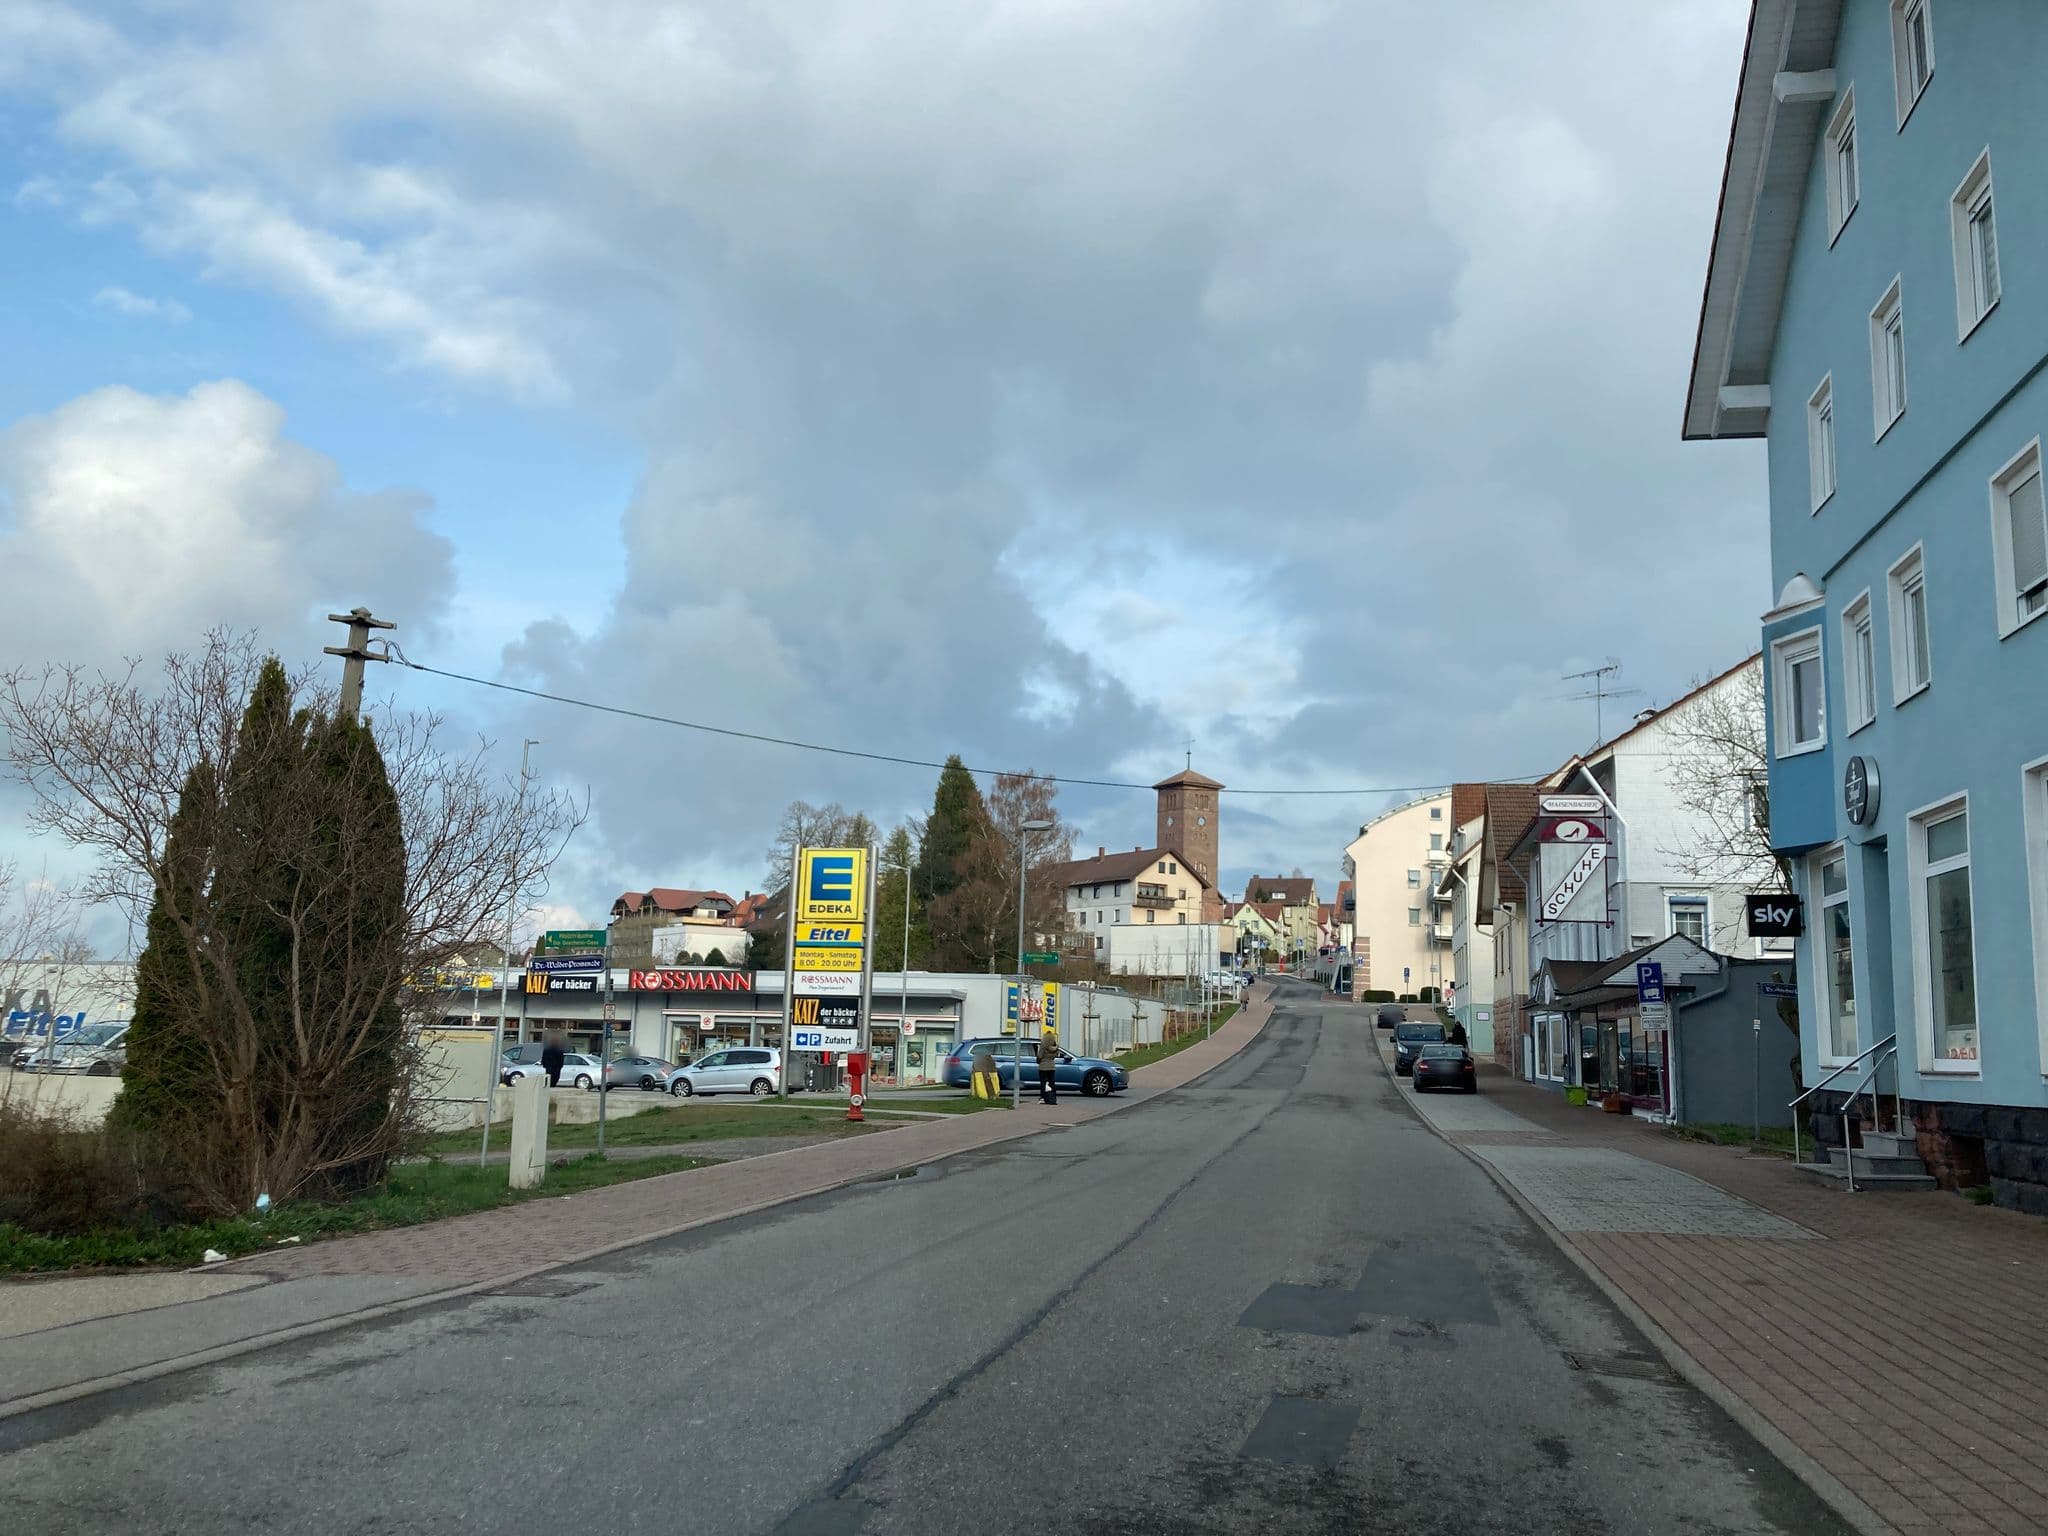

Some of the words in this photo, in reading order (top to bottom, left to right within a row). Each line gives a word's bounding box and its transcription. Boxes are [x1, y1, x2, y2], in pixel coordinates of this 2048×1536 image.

[1548, 848, 1600, 915] SCHUHE
[809, 905, 852, 913] EDEKA
[1754, 903, 1794, 927] sky
[810, 928, 851, 940] Eitel
[631, 971, 752, 991] ROSSMANN
[801, 975, 853, 984] ROSSMANN
[1641, 967, 1653, 983] P
[550, 980, 564, 989] der
[565, 980, 592, 990] bäcker
[794, 998, 820, 1025] KATZ
[820, 1008, 832, 1016] der
[833, 1007, 857, 1017] bäcker
[1046, 992, 1055, 1027] Eitel
[825, 1036, 852, 1045] Zufahrt
